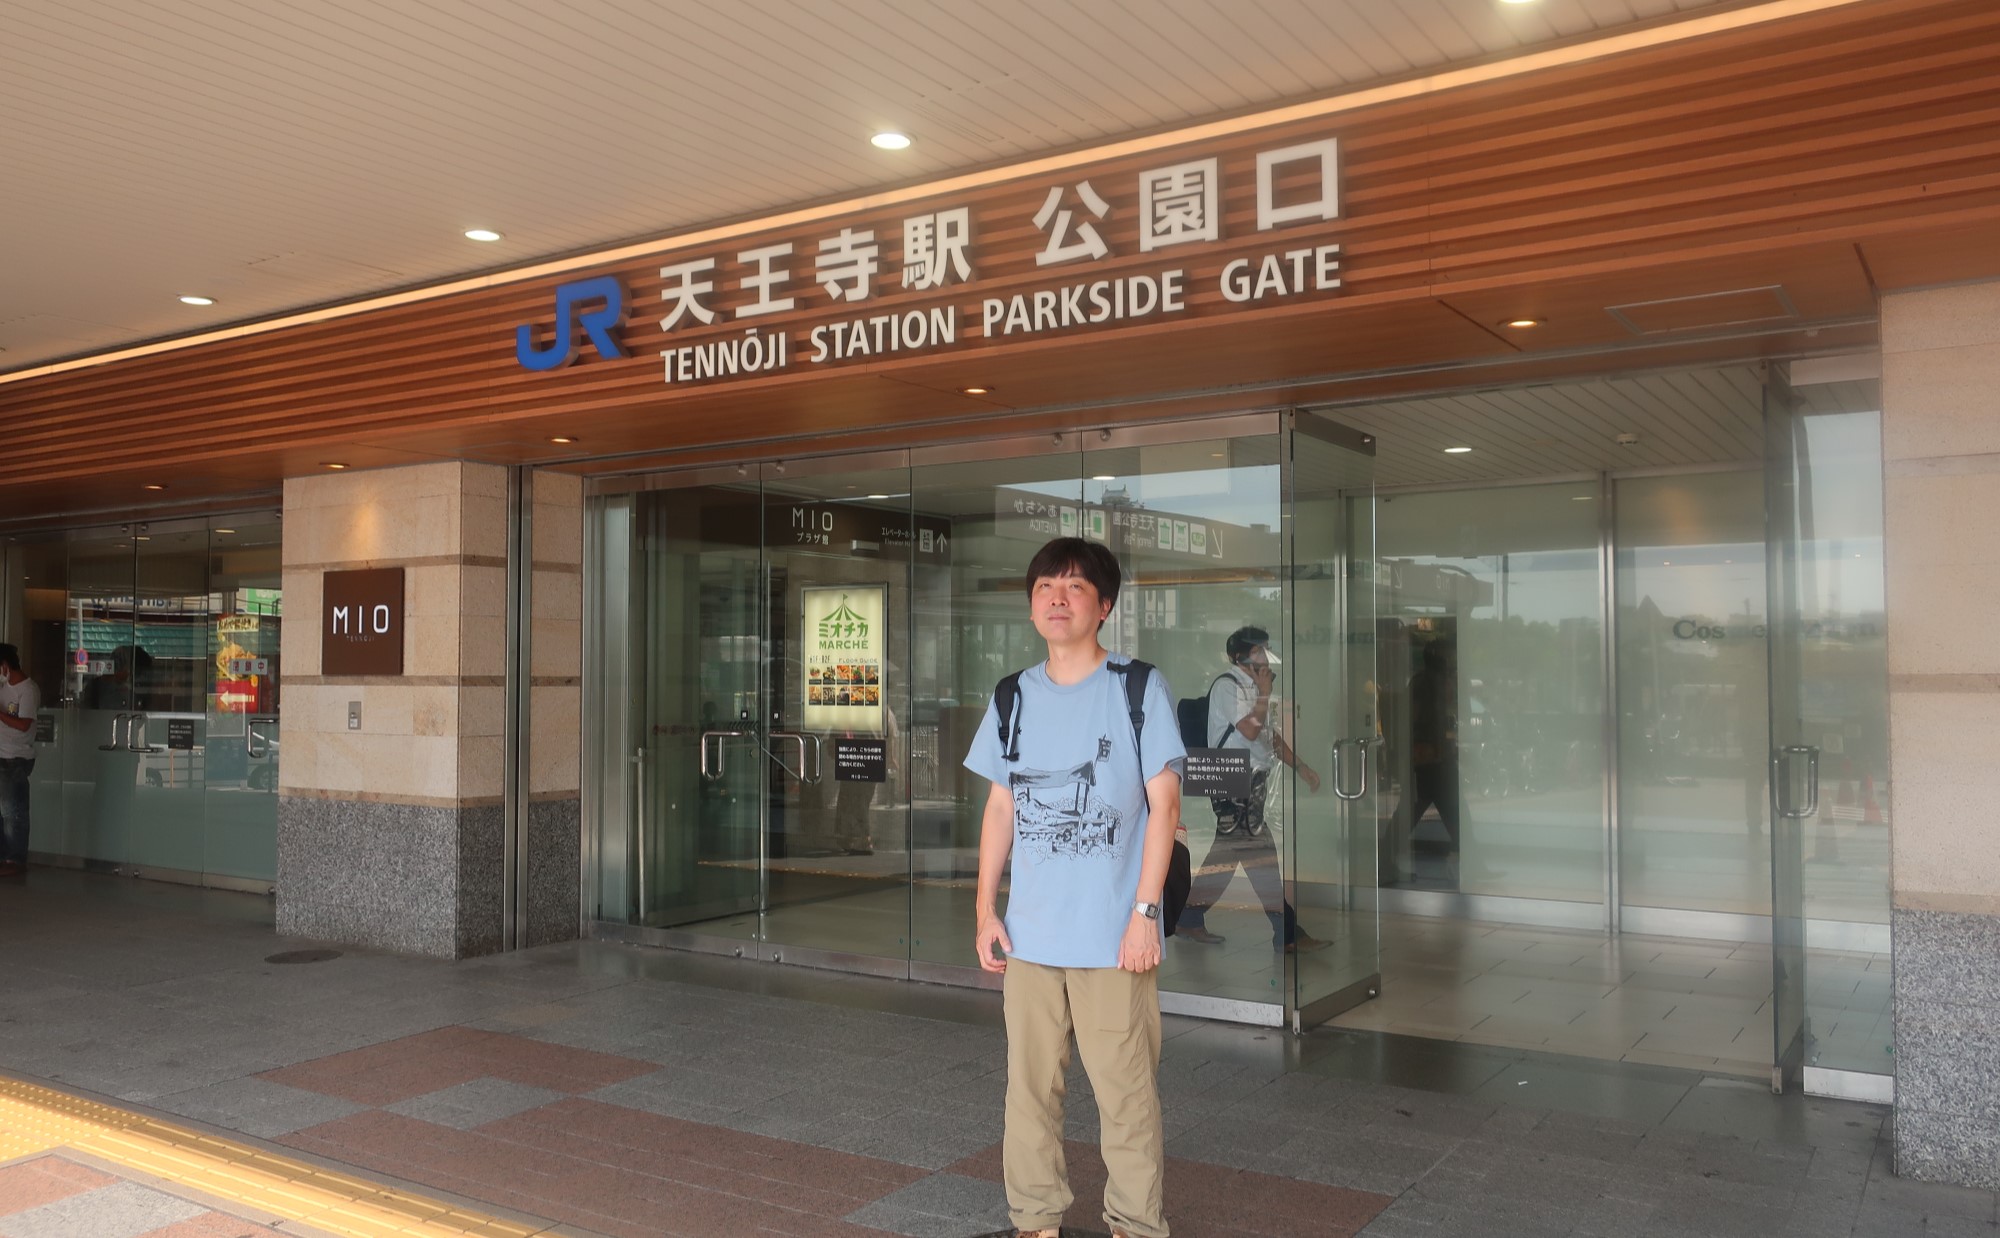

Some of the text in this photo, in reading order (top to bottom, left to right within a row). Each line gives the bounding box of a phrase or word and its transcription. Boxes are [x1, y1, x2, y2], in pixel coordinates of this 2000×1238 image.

[659, 137, 1340, 332] 天王寺駅 公園口
[516, 276, 623, 371] JR
[660, 244, 1341, 383] TENNŌJI STATION PARKSIDE GATE
[792, 507, 834, 531] MIO
[797, 531, 830, 546] プラザ館
[332, 604, 389, 634] MIO
[819, 622, 869, 638] ミオチカ
[819, 638, 869, 650] MARCHÉ
